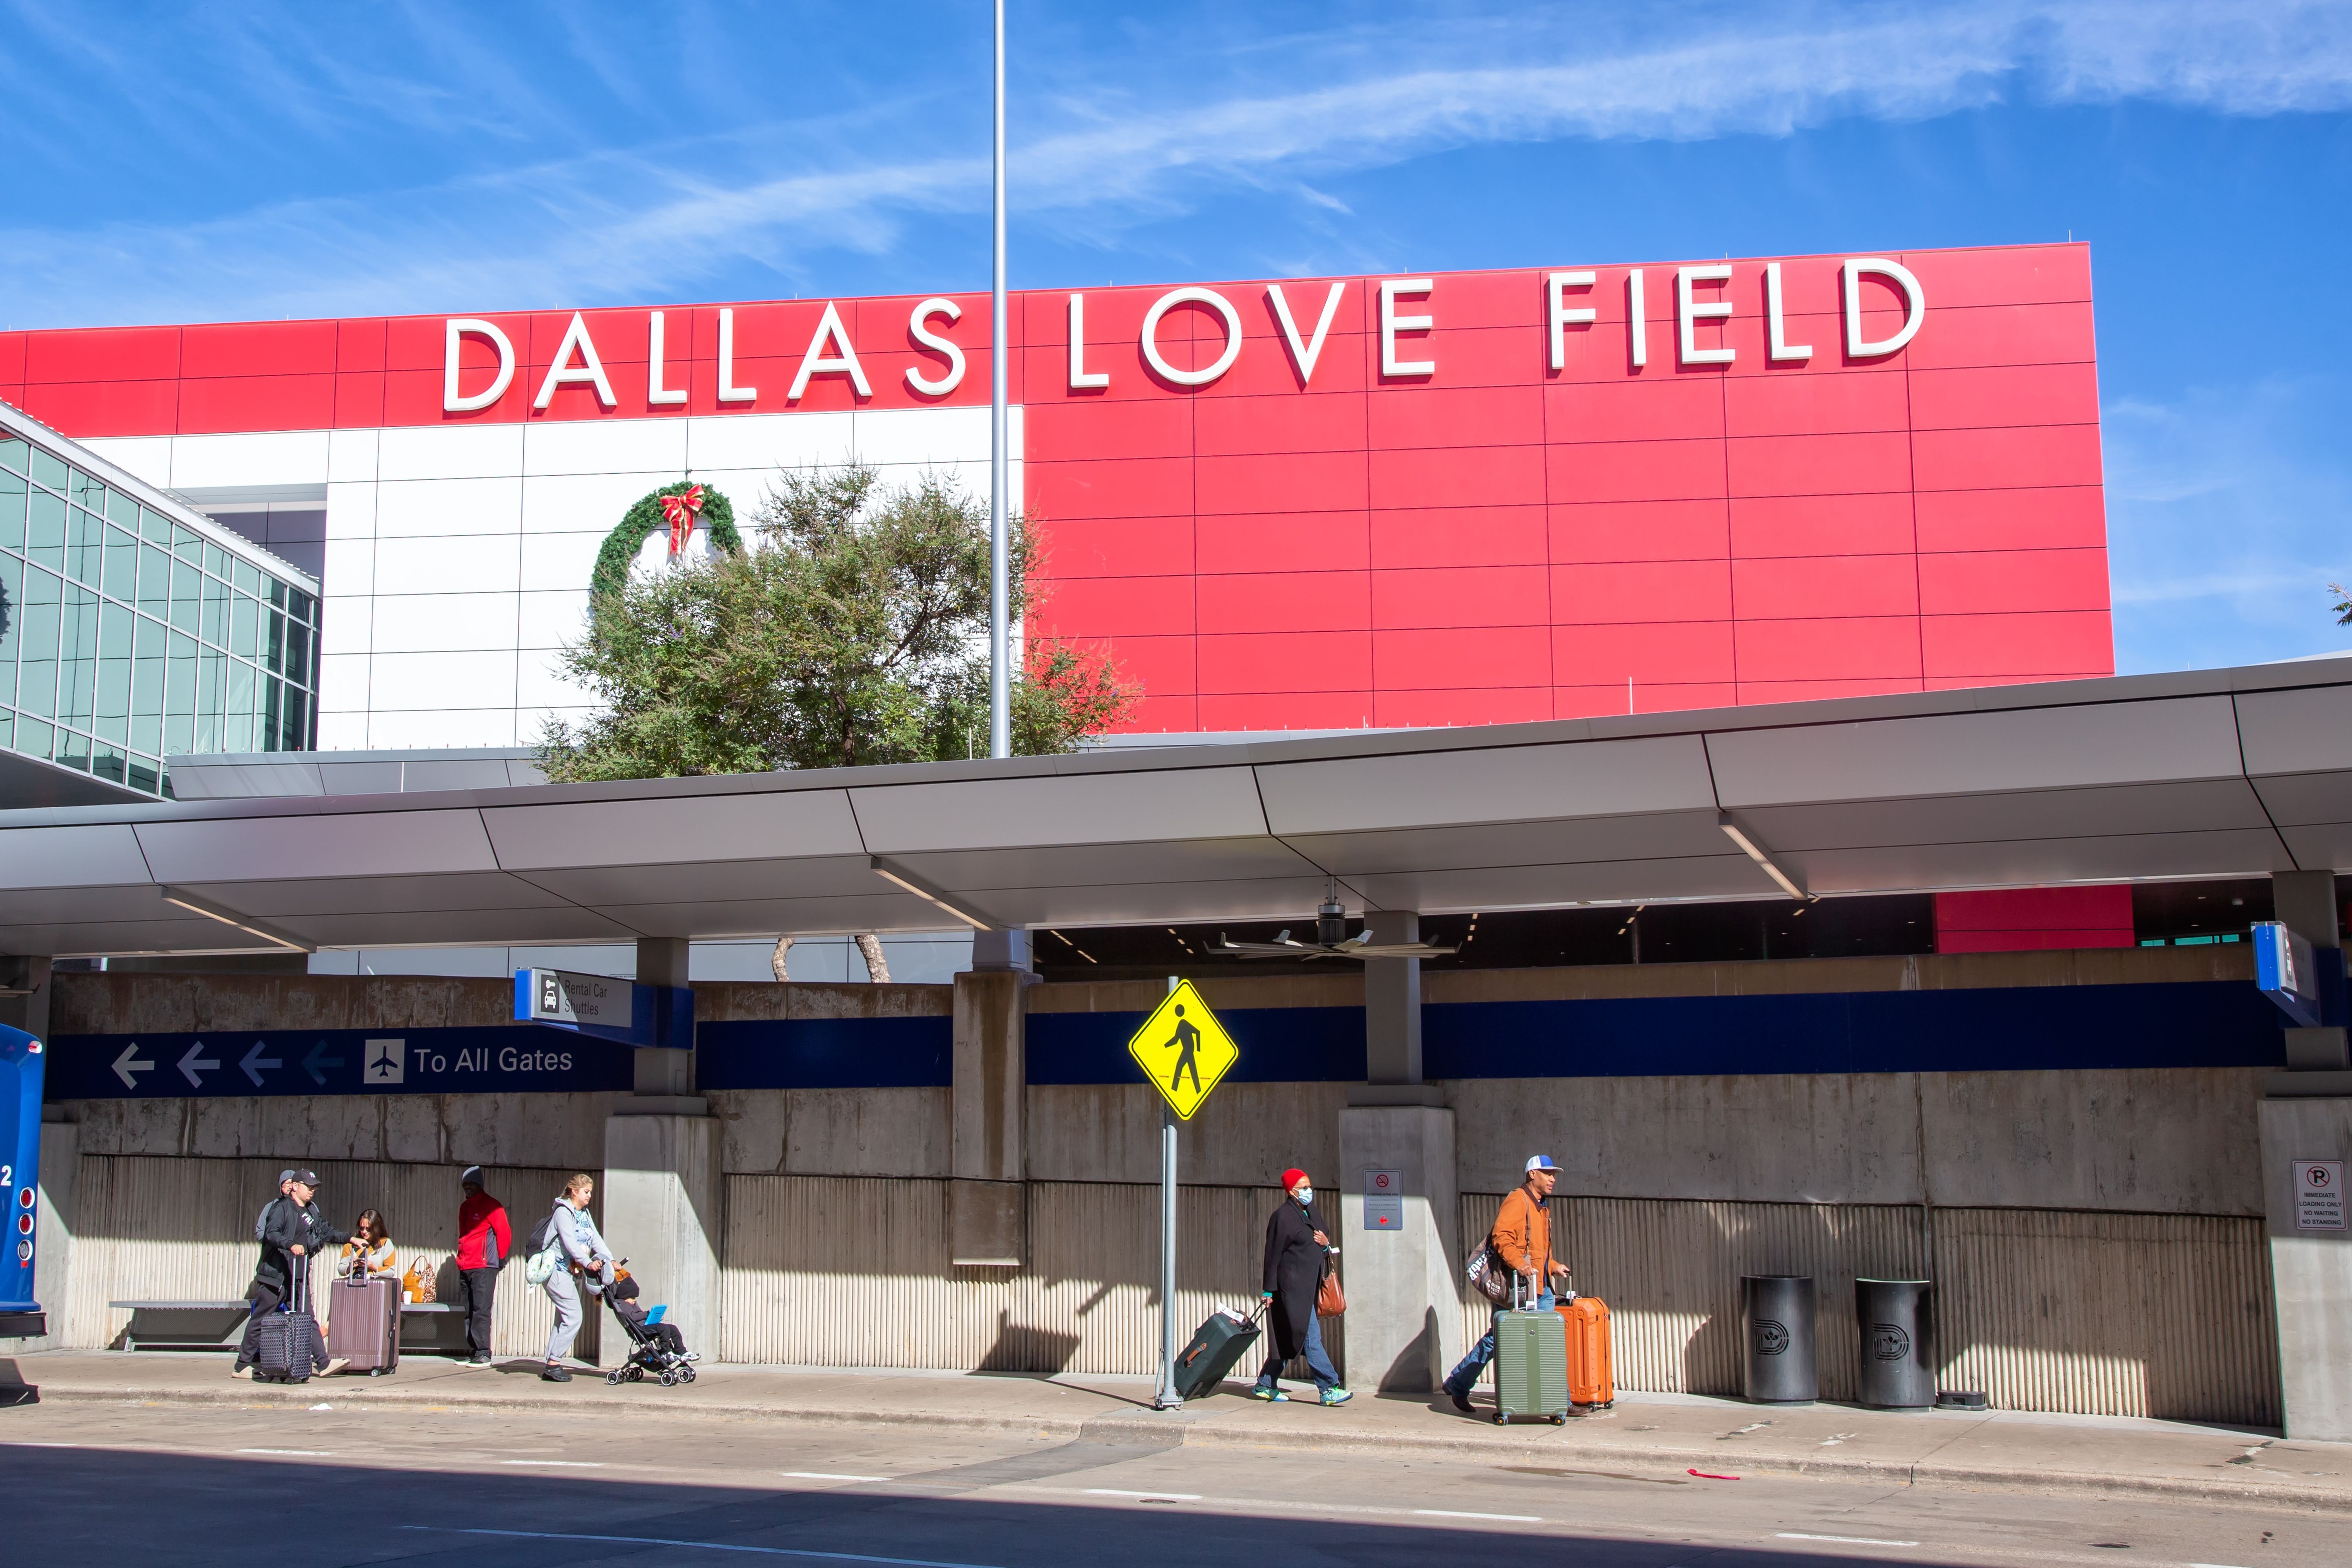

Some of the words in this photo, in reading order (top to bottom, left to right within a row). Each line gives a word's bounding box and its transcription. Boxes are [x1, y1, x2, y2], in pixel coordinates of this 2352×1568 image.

[444, 298, 966, 412] DALLAS
[1070, 278, 1436, 388] LOVE
[1549, 257, 1925, 369] FIELD
[565, 980, 591, 996] Rental
[593, 983, 608, 998] Car
[565, 998, 598, 1016] Shuttles
[414, 1049, 445, 1072] To
[454, 1048, 488, 1071] All
[499, 1047, 572, 1071] Gates
